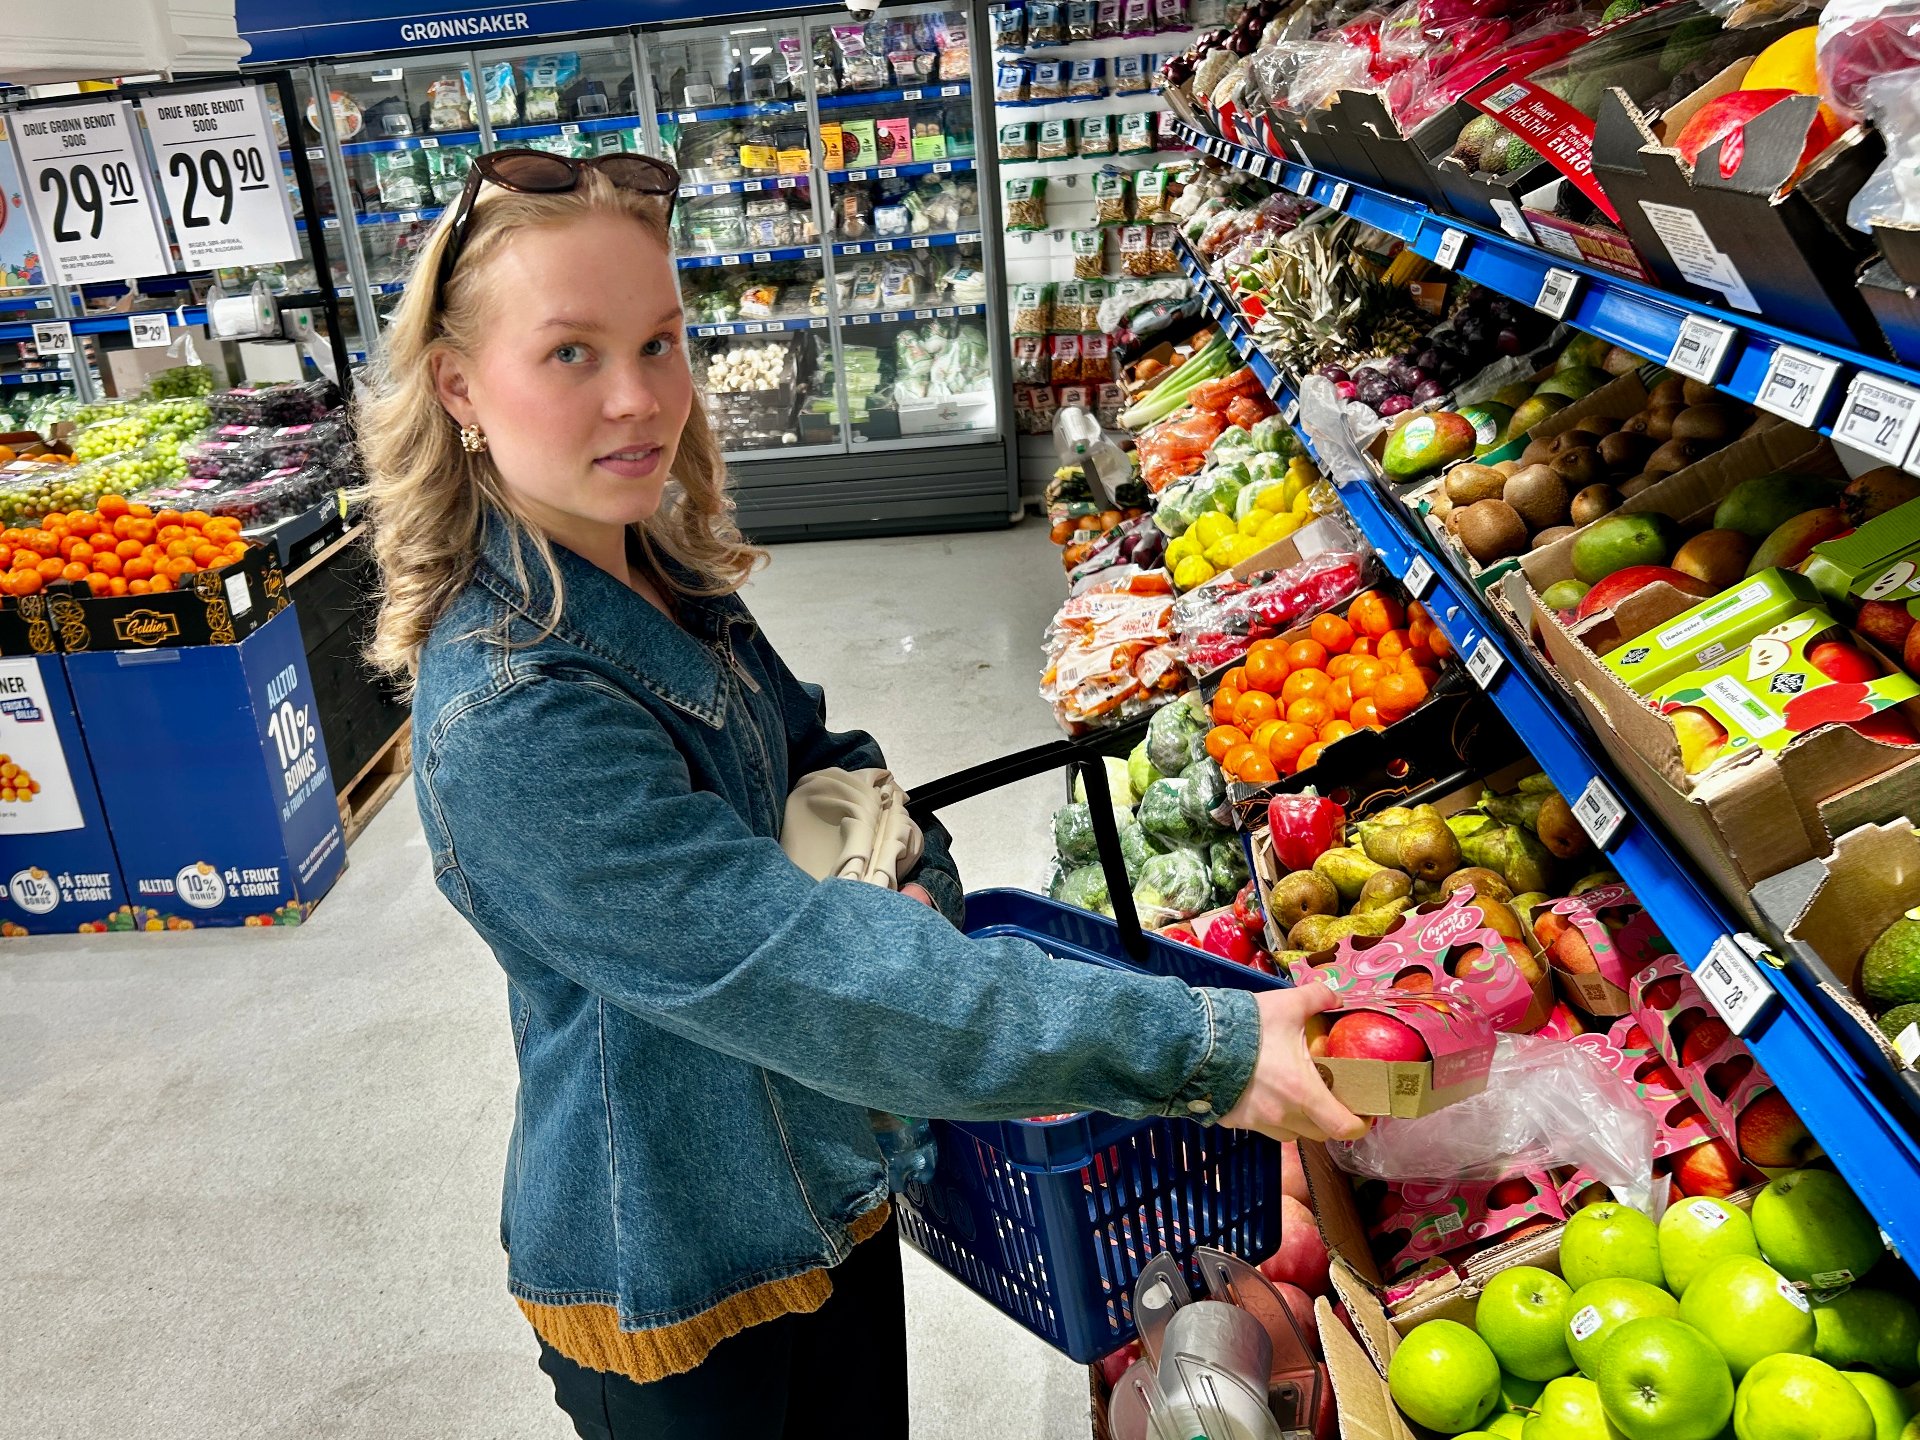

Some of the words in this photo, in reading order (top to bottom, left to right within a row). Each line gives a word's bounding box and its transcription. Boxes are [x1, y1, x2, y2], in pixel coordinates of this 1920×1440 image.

[400, 12, 530, 42] GRØNNSAKER
[158, 105, 184, 121] DRUE
[184, 102, 211, 118] RØDE
[211, 98, 245, 116] BENDIT
[1505, 105, 1552, 138] HEALTHY
[1528, 101, 1556, 121] Heart
[22, 122, 49, 137] DRUE
[50, 117, 82, 133] GRØNN
[84, 113, 116, 130] BENDIT
[192, 118, 218, 133] 500G
[61, 133, 87, 148] 500G
[1546, 136, 1593, 177] ENERGY
[169, 149, 234, 229] 29
[233, 147, 265, 184] 90
[40, 164, 103, 243] 29
[101, 161, 134, 198] 90
[52, 333, 65, 349] 29
[149, 325, 161, 341] 29
[1790, 382, 1809, 410] 29
[1874, 415, 1897, 447] 22
[126, 617, 168, 637] Goldies
[266, 663, 298, 710] ALLTID
[267, 701, 316, 769] 10%
[284, 747, 317, 797] BONUS
[282, 801, 292, 822] PÅ
[289, 787, 306, 812] FRUKT
[305, 783, 312, 798] &
[310, 765, 328, 793] GRØNT
[57, 871, 74, 889] PÅ
[74, 873, 111, 888] FRUKT
[139, 879, 175, 893] ALLTID
[182, 874, 217, 893] 10%
[224, 866, 241, 885] PÅ
[241, 867, 280, 883] FRUKT
[16, 879, 51, 898] 10%
[62, 888, 74, 903] &
[74, 886, 112, 902] GRØNT
[189, 892, 218, 901] BONUS
[228, 884, 240, 898] &
[240, 881, 280, 898] GRØNT
[1426, 908, 1463, 939] Lady
[1431, 911, 1473, 946] Pink
[1724, 985, 1743, 1010] 28
